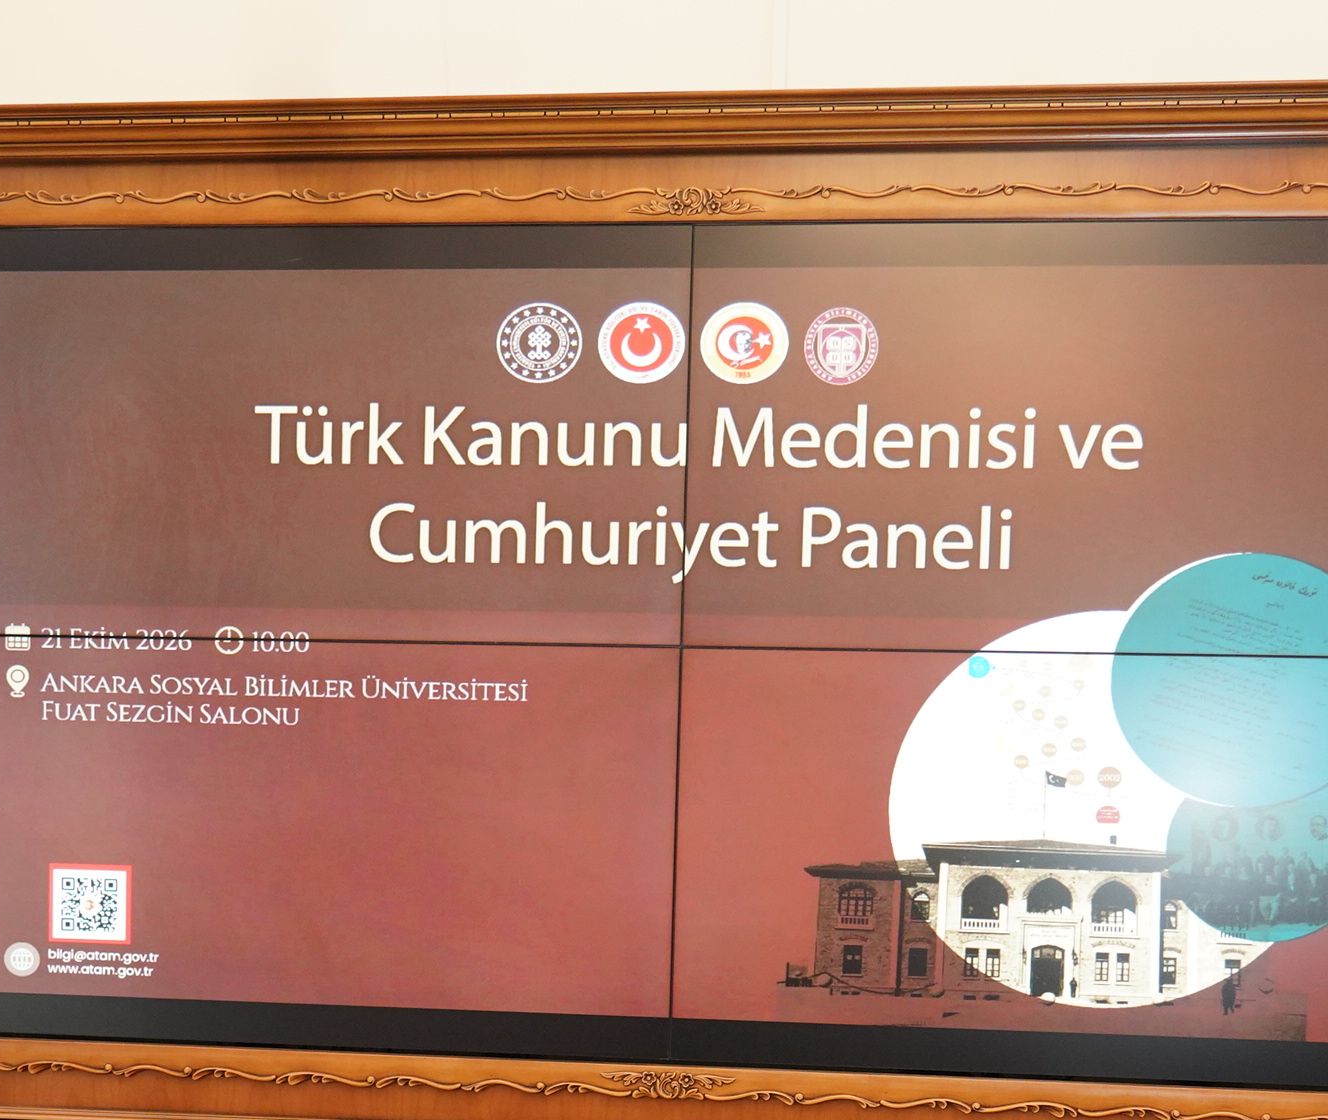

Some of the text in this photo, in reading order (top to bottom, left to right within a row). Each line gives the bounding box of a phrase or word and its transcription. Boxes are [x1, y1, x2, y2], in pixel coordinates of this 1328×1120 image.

[255, 402, 1143, 470] Türk Kanunu Medenisi ve
[370, 502, 1013, 585] Cumhuriyet Paneli
[41, 628, 62, 649] 21
[136, 630, 192, 652] 2026
[252, 631, 310, 653] 10.00
[47, 948, 159, 965] bilgi@atam.gov.tr
[47, 964, 153, 979] www.atam.gov.tr
